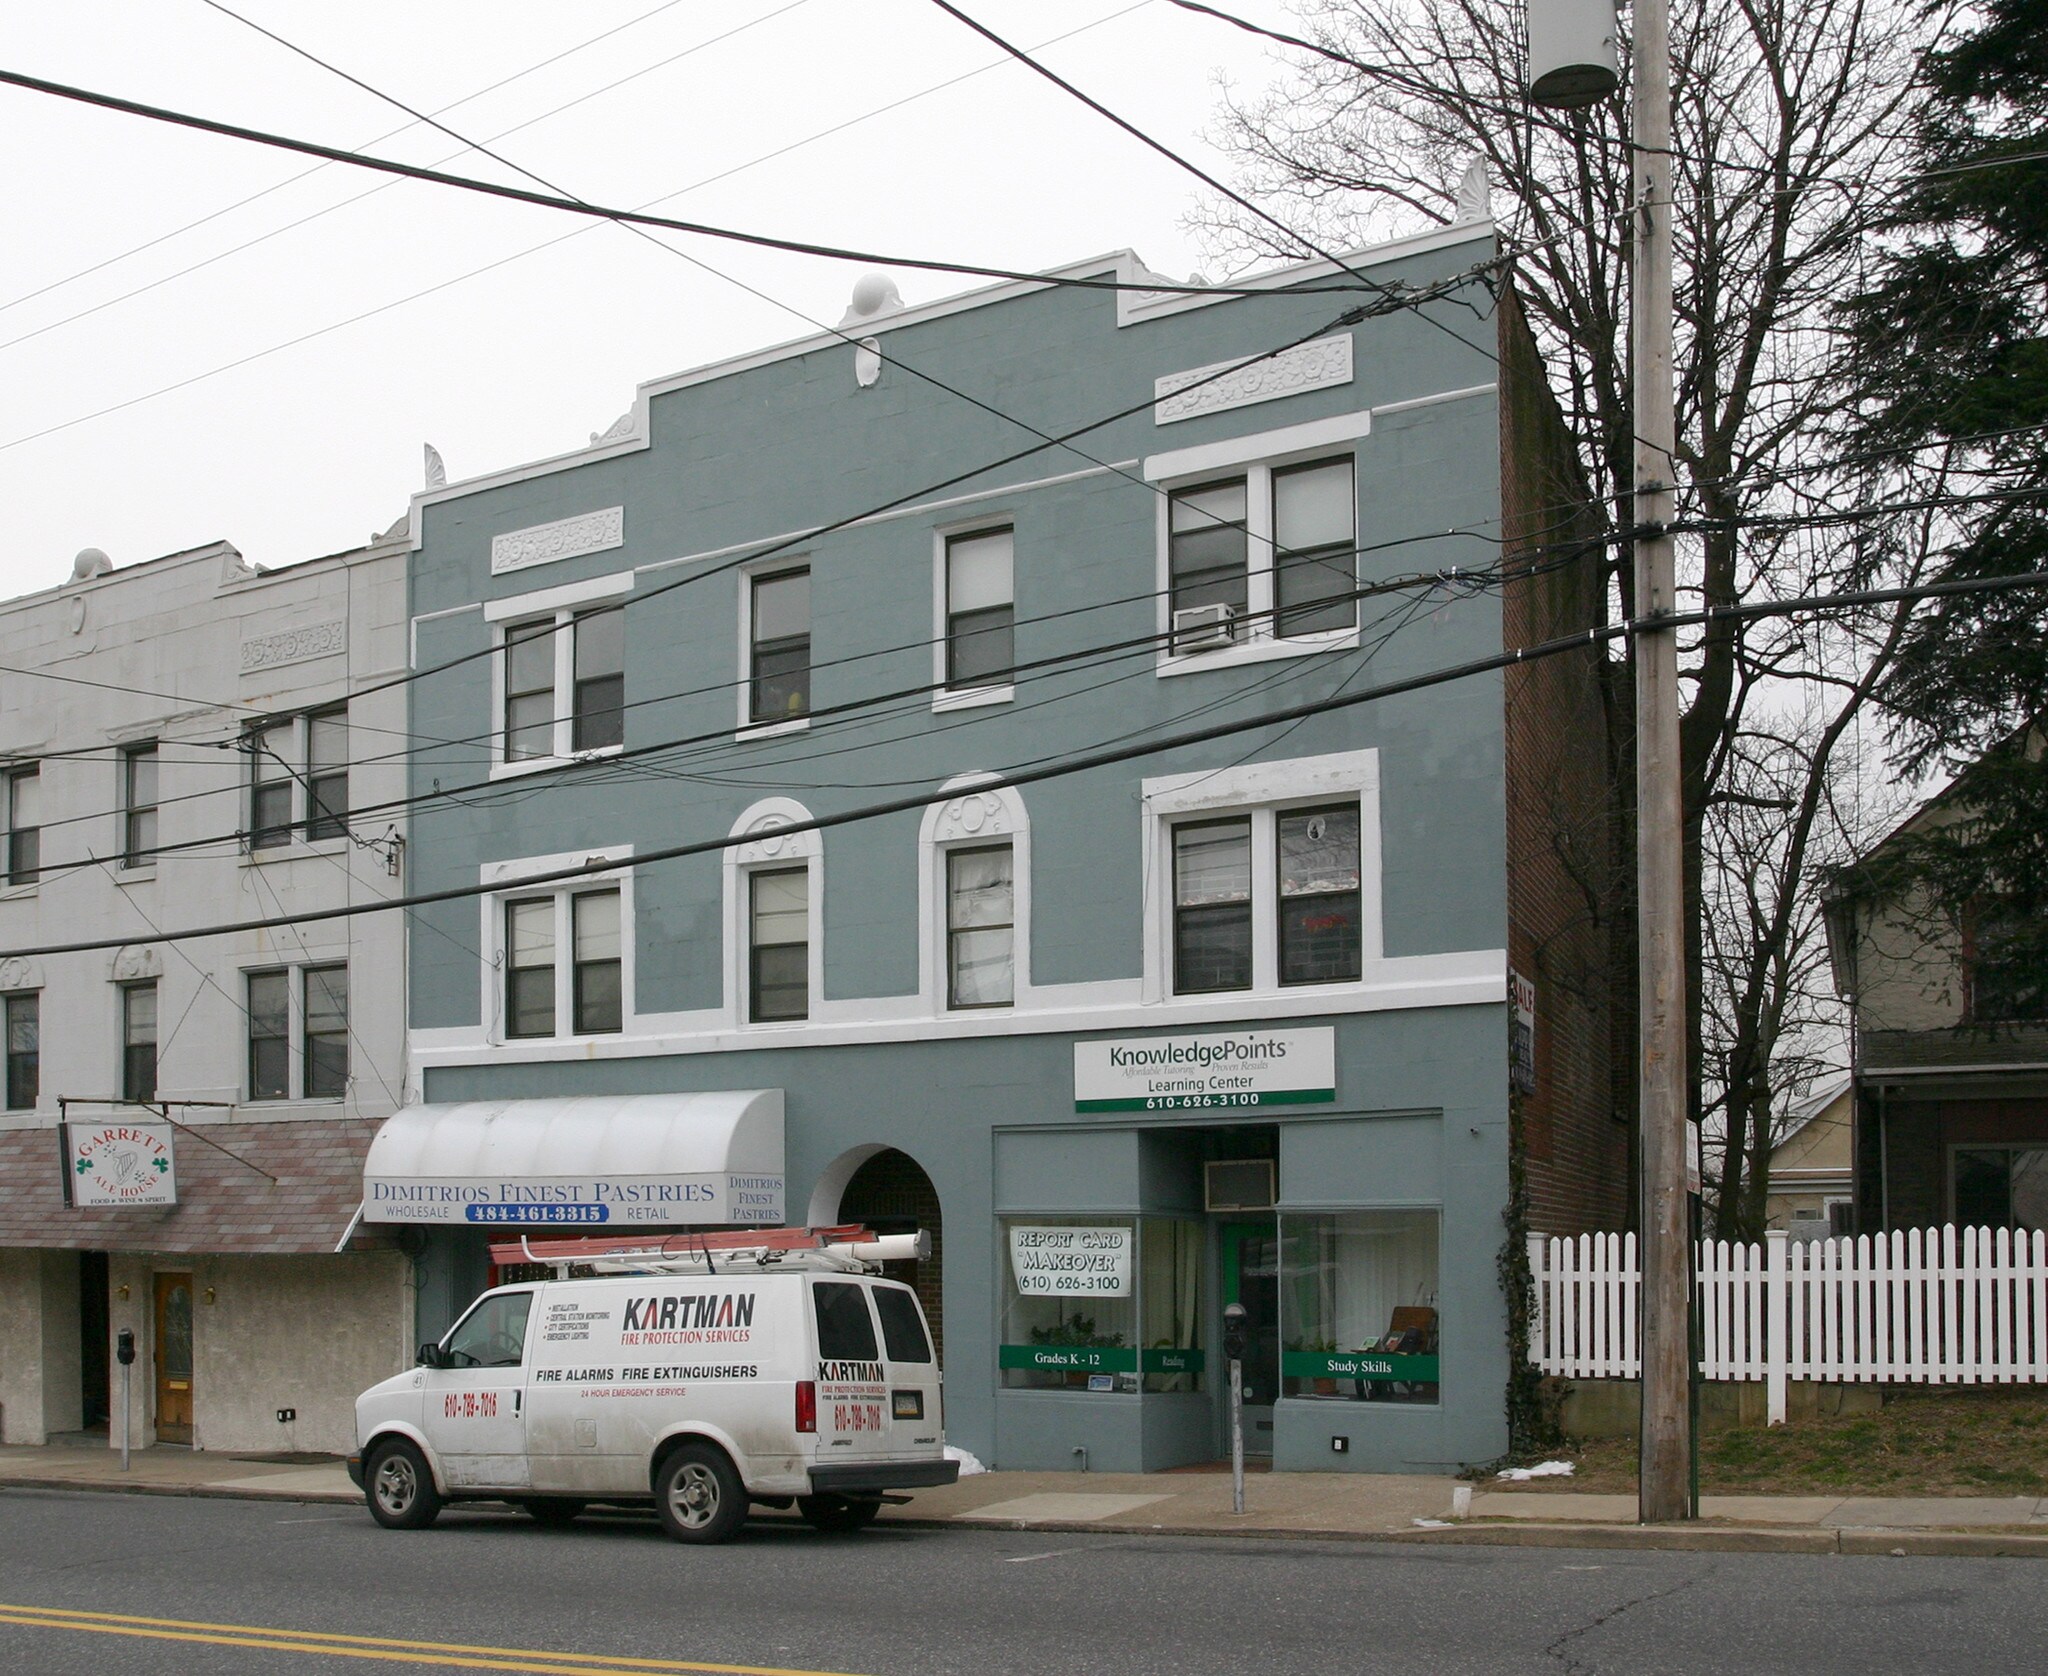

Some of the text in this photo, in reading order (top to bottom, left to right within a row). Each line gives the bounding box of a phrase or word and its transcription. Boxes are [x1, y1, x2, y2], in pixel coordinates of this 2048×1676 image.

[1110, 1035, 1286, 1067] KnowledgePoints
[1121, 1060, 1269, 1079] Affordable Tutoring Proven Results
[1148, 1075, 1254, 1092] Learning Center
[1146, 1093, 1259, 1109] 610-626-3100
[78, 1127, 167, 1157] GARRETT
[93, 1174, 160, 1197] ALE HOUSE
[730, 1176, 782, 1189] DIMITRIOS
[373, 1182, 715, 1202] DIMITRIOS FINEST PASTRIES
[738, 1191, 774, 1205] FINEST
[386, 1205, 449, 1218] WHOLESALE
[474, 1206, 600, 1221] 484-461-3315
[627, 1206, 670, 1220] RETAIL
[733, 1207, 781, 1220] PASTRIES
[1018, 1231, 1123, 1249] REPORT CARD
[1019, 1275, 1120, 1292] (610) 626-3100
[623, 1293, 756, 1331] KARTMAN
[621, 1329, 750, 1346] FIRE PROTECTION SERVICES
[1034, 1352, 1068, 1365] Grades
[1070, 1353, 1078, 1365] K
[1089, 1354, 1100, 1365] 12
[1327, 1359, 1392, 1374] Study Skills
[536, 1365, 758, 1382] FIRE ALARMS FIRE EXTINGUISHERS
[818, 1362, 885, 1382] KARTMAN
[581, 1387, 686, 1398] 24 HOUR EMERGENCY SERVICE
[822, 1385, 833, 1393] FIRE
